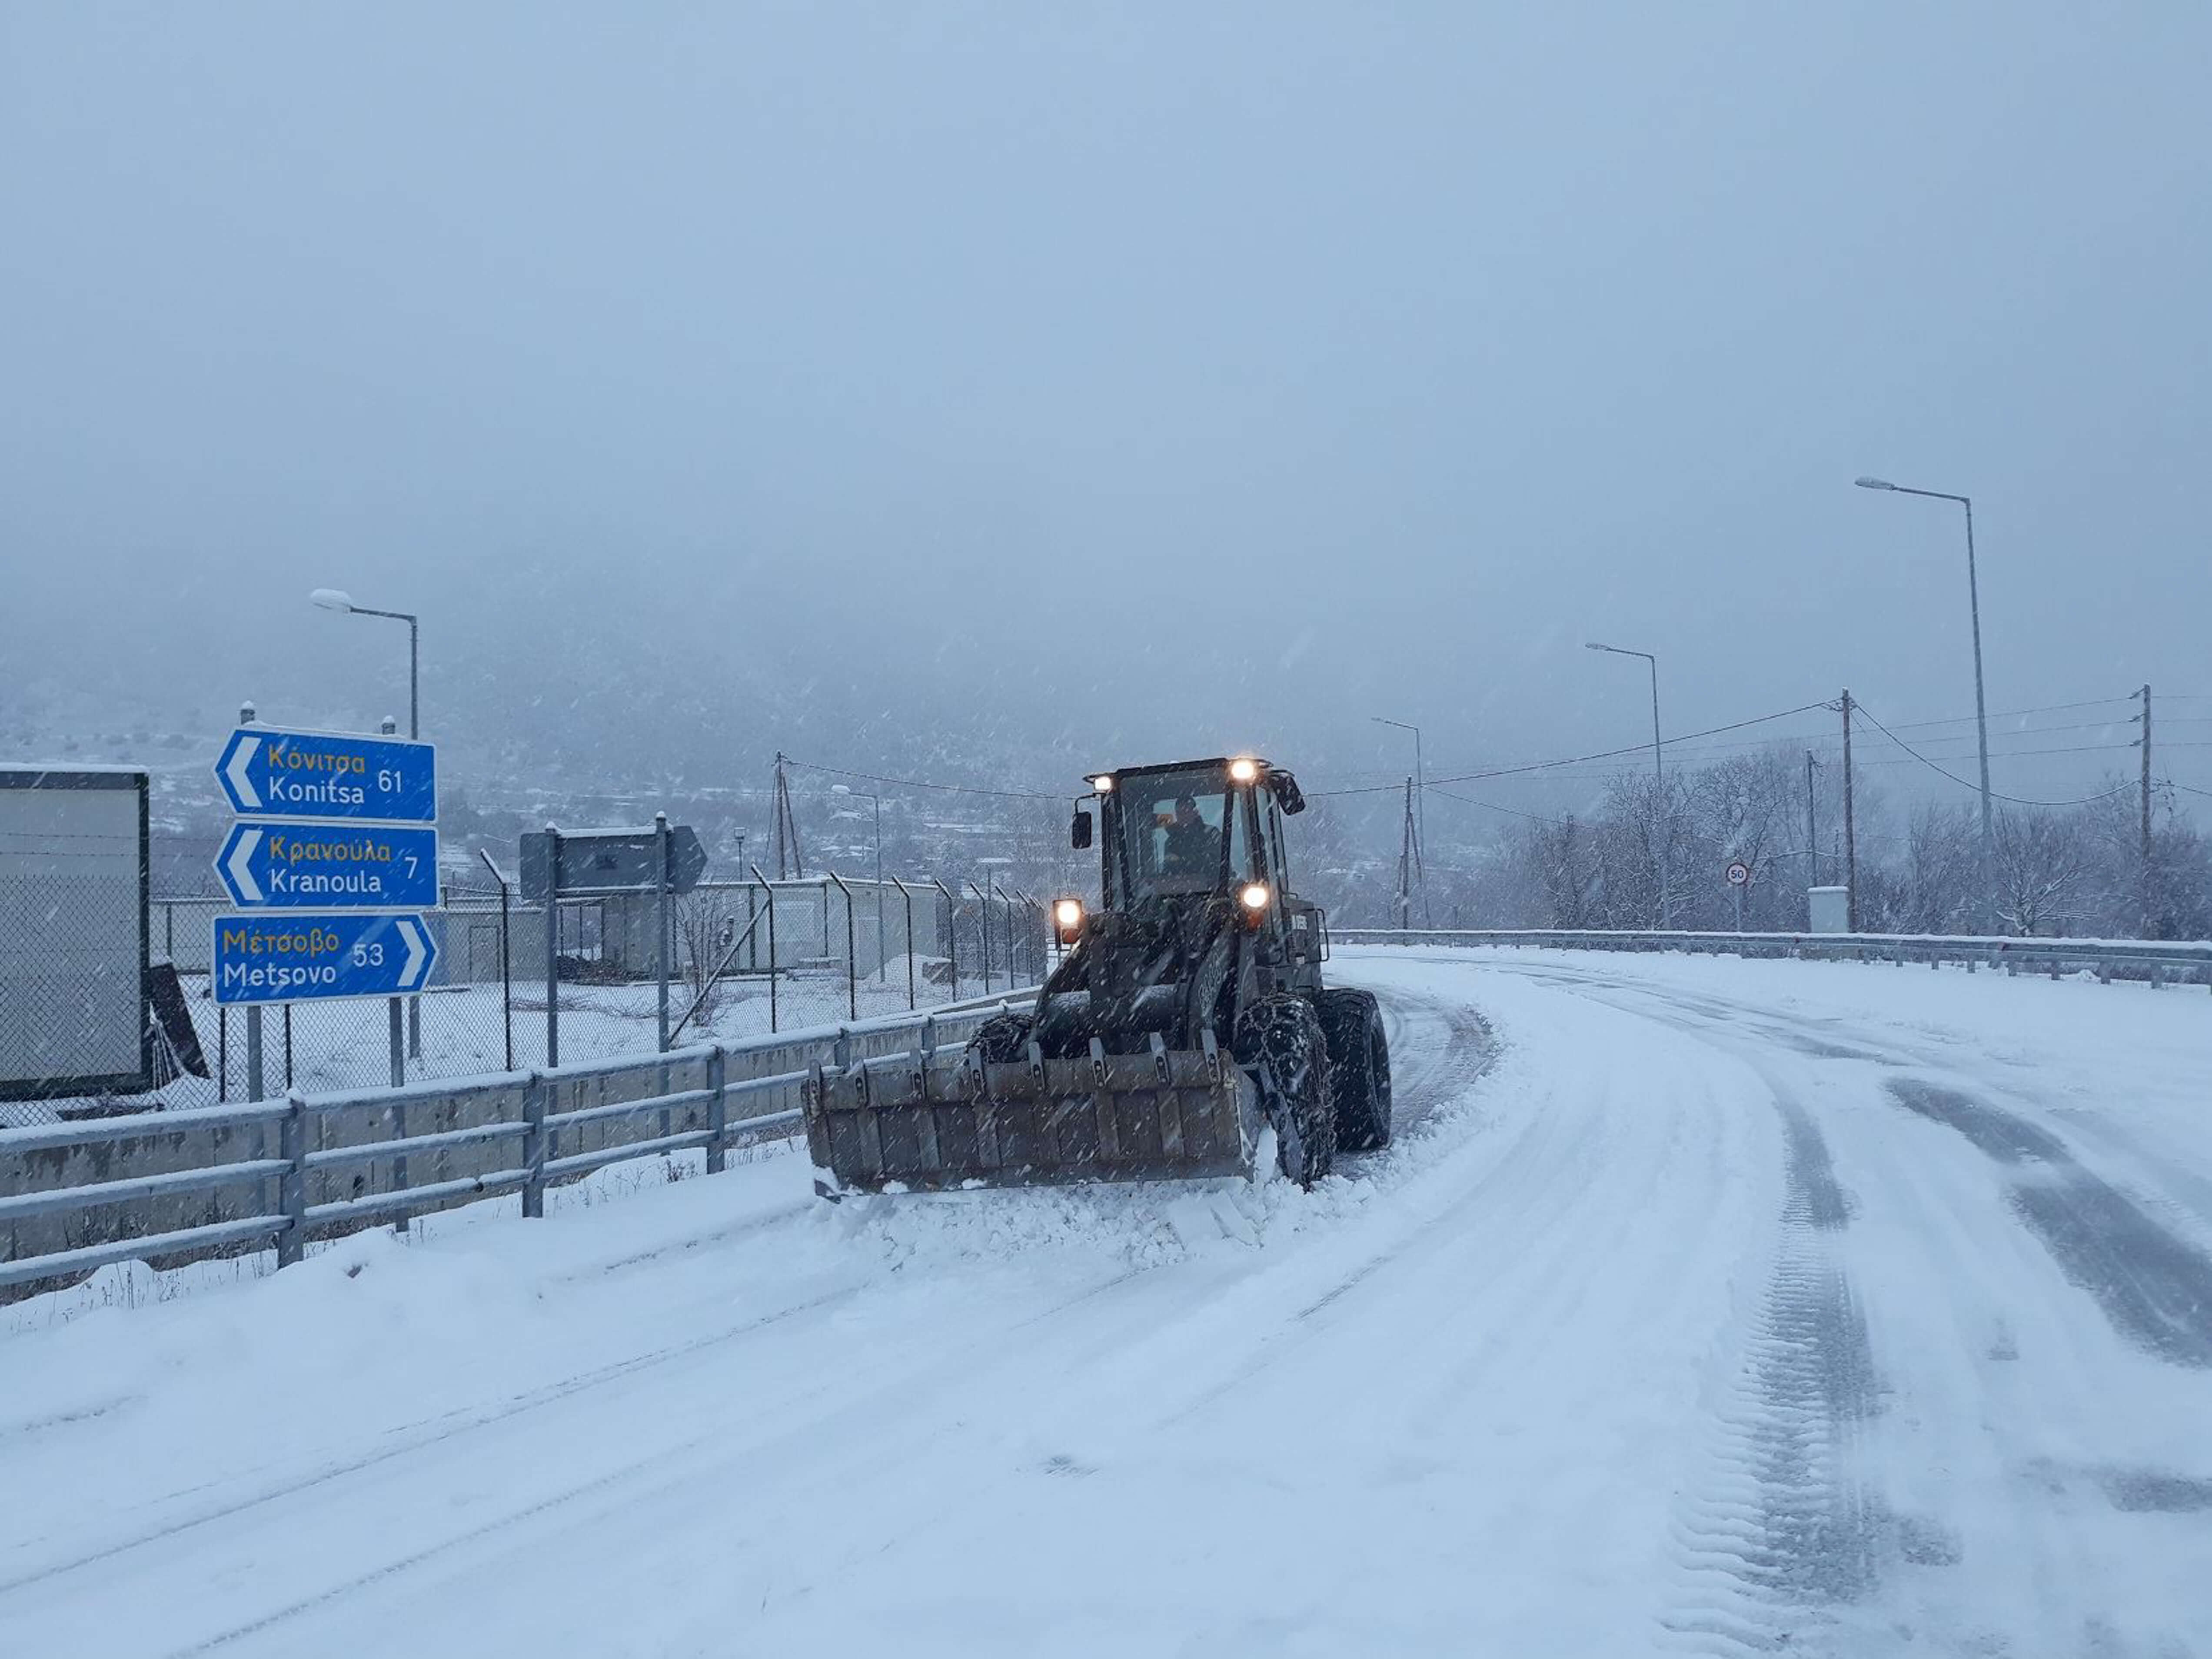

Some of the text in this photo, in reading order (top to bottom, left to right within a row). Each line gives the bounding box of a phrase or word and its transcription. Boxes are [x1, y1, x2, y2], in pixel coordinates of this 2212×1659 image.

[268, 744, 365, 774] Κόνιτσα
[269, 776, 364, 804] Konitsa
[379, 769, 402, 793] 61
[270, 836, 390, 867] Κρανούλα
[405, 856, 418, 879] 7
[1731, 870, 1744, 879] 50
[270, 869, 382, 892] Kranoula
[223, 928, 339, 958] Μέτσοβο
[353, 944, 383, 967] 53
[224, 962, 336, 987] Metsovo
